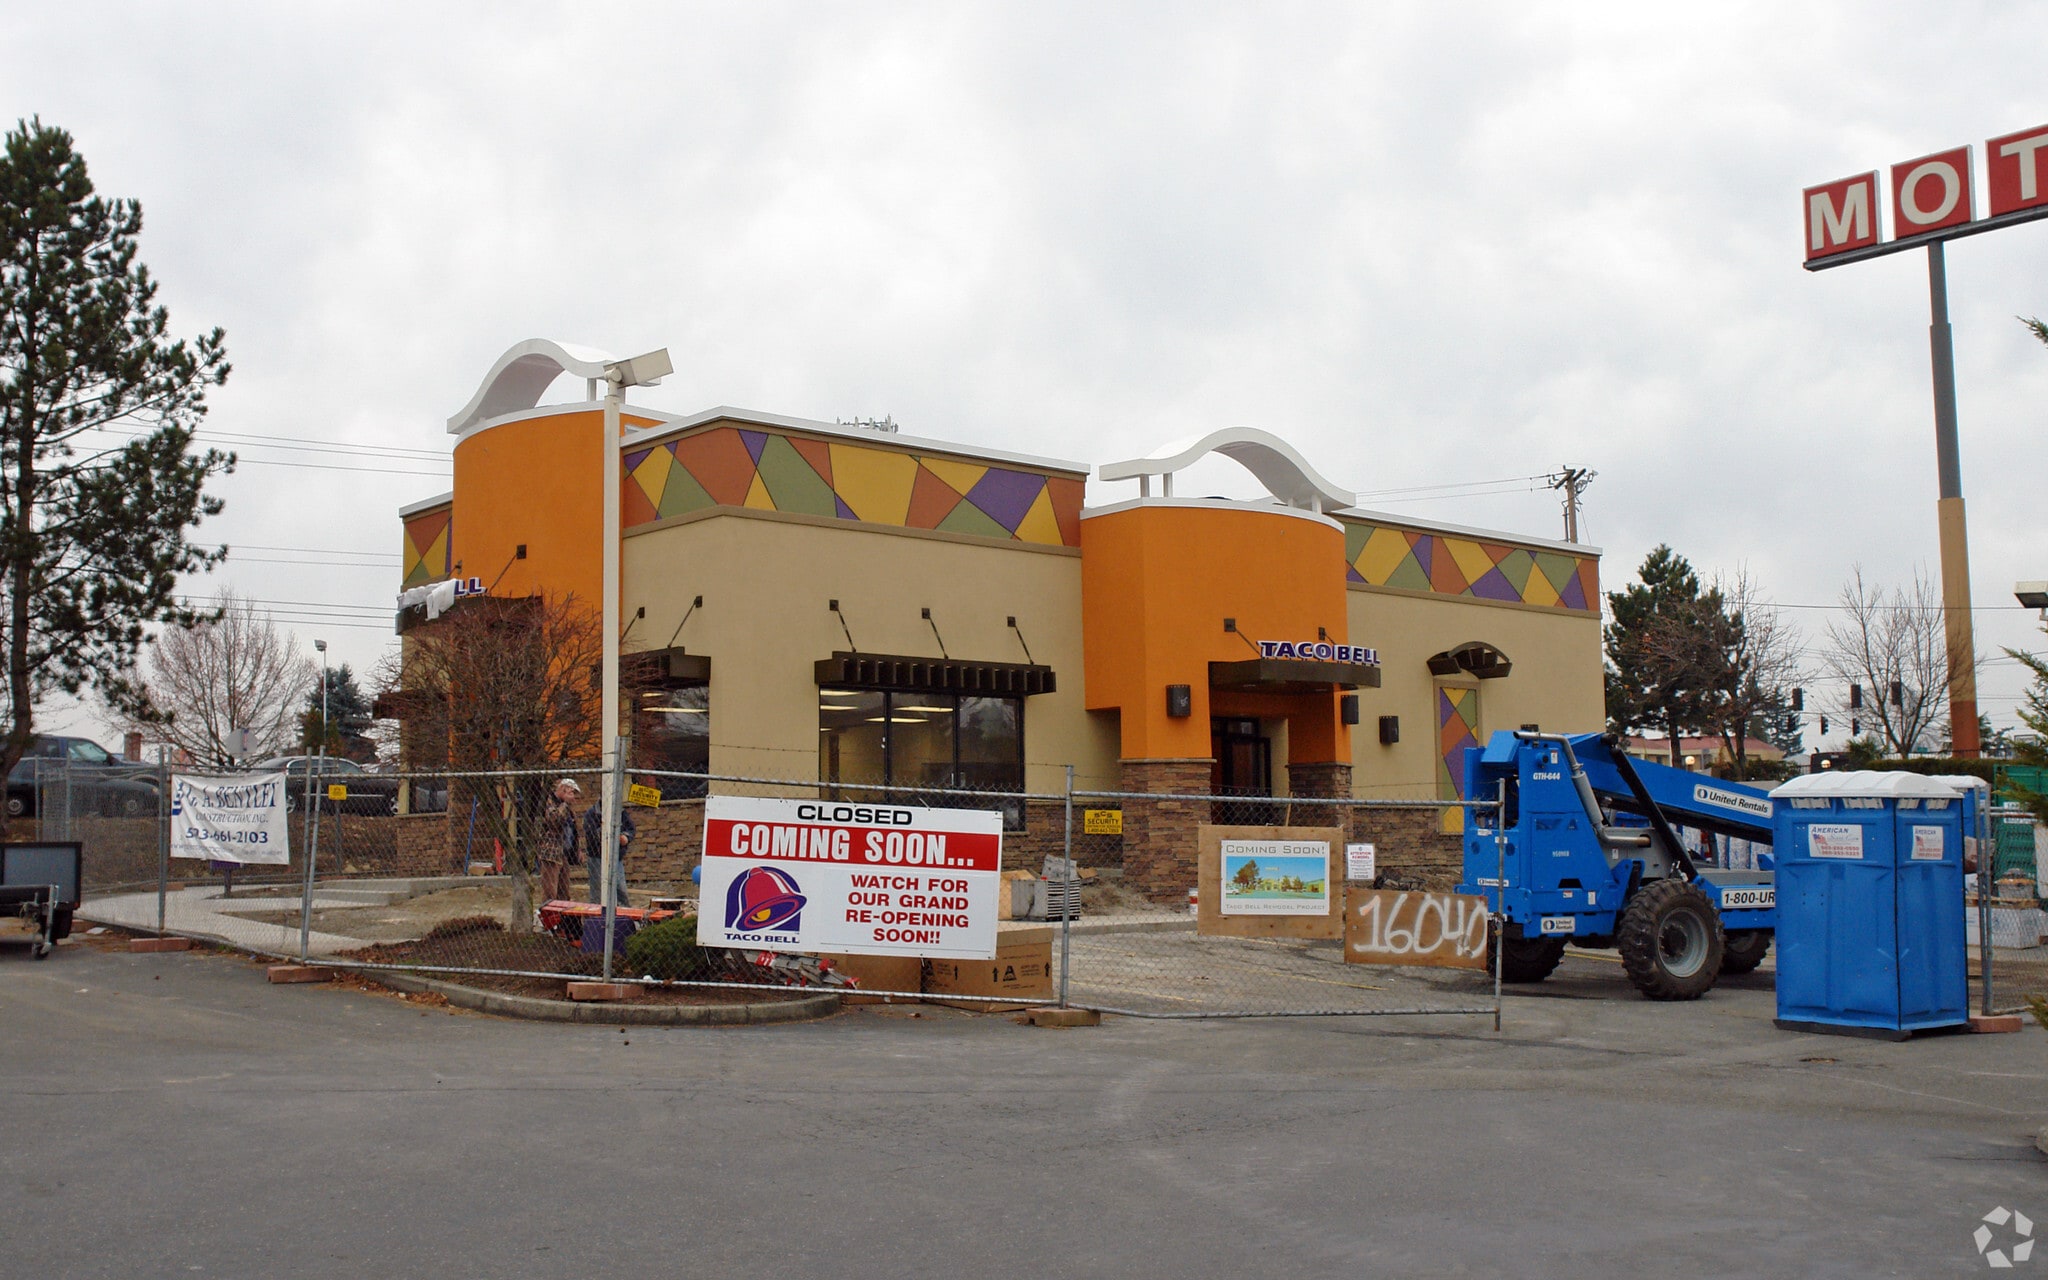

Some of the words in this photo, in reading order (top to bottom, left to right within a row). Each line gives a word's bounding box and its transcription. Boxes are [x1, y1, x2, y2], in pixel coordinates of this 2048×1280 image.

[1257, 640, 1333, 660] TACO
[1333, 644, 1381, 665] BELL
[1708, 792, 1737, 806] United
[1738, 799, 1769, 813] Rentals
[797, 804, 913, 826] CLOSED
[1811, 826, 1849, 834] AMERICAN
[730, 823, 851, 860] COMING
[865, 831, 975, 867] SOON...
[850, 874, 919, 891] WATCH
[927, 878, 969, 893] FOR
[847, 891, 890, 907] OUR
[898, 894, 969, 910] GRAND
[1724, 891, 1775, 904] 1-800-UR
[845, 909, 969, 928] RE-OPENING
[724, 932, 762, 942] TACO
[764, 934, 800, 943] BELL
[873, 928, 941, 944] SOON!!
